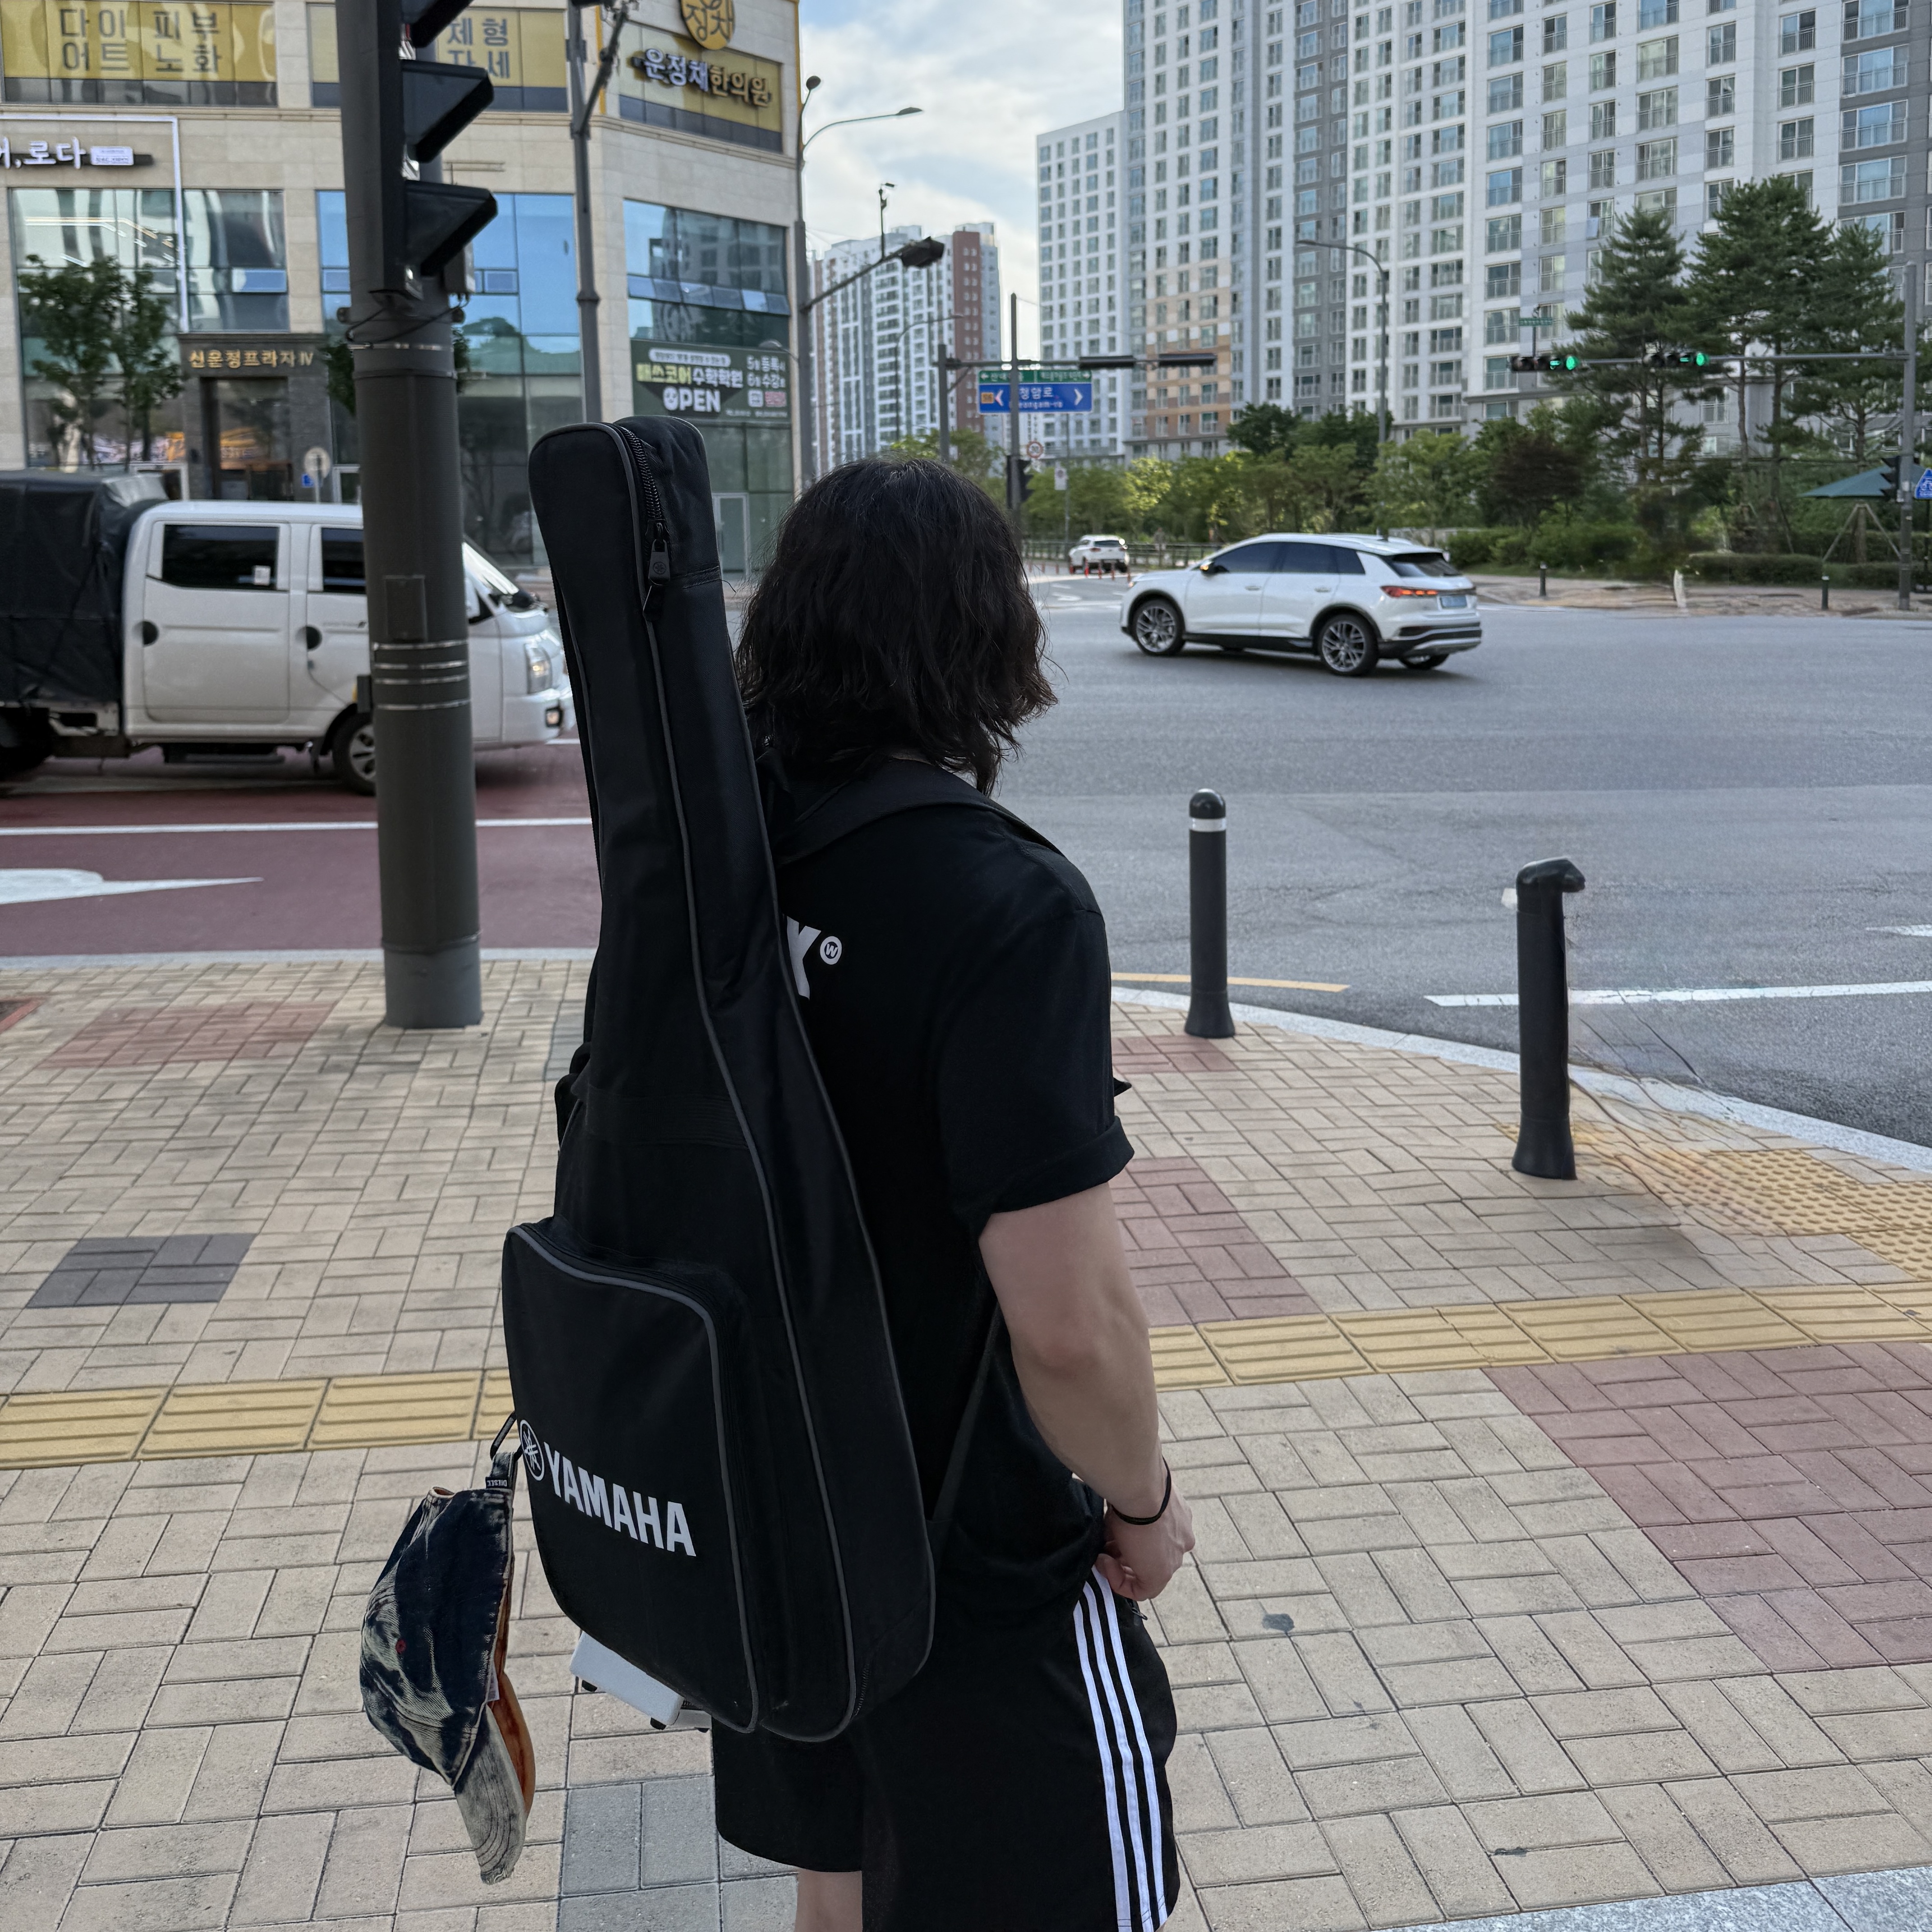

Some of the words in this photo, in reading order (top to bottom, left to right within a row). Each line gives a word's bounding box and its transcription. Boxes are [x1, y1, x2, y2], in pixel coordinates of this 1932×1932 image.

[447, 17, 508, 46] 체형
[663, 386, 721, 413] OPEN
[544, 1441, 697, 1557] YAMAHA
